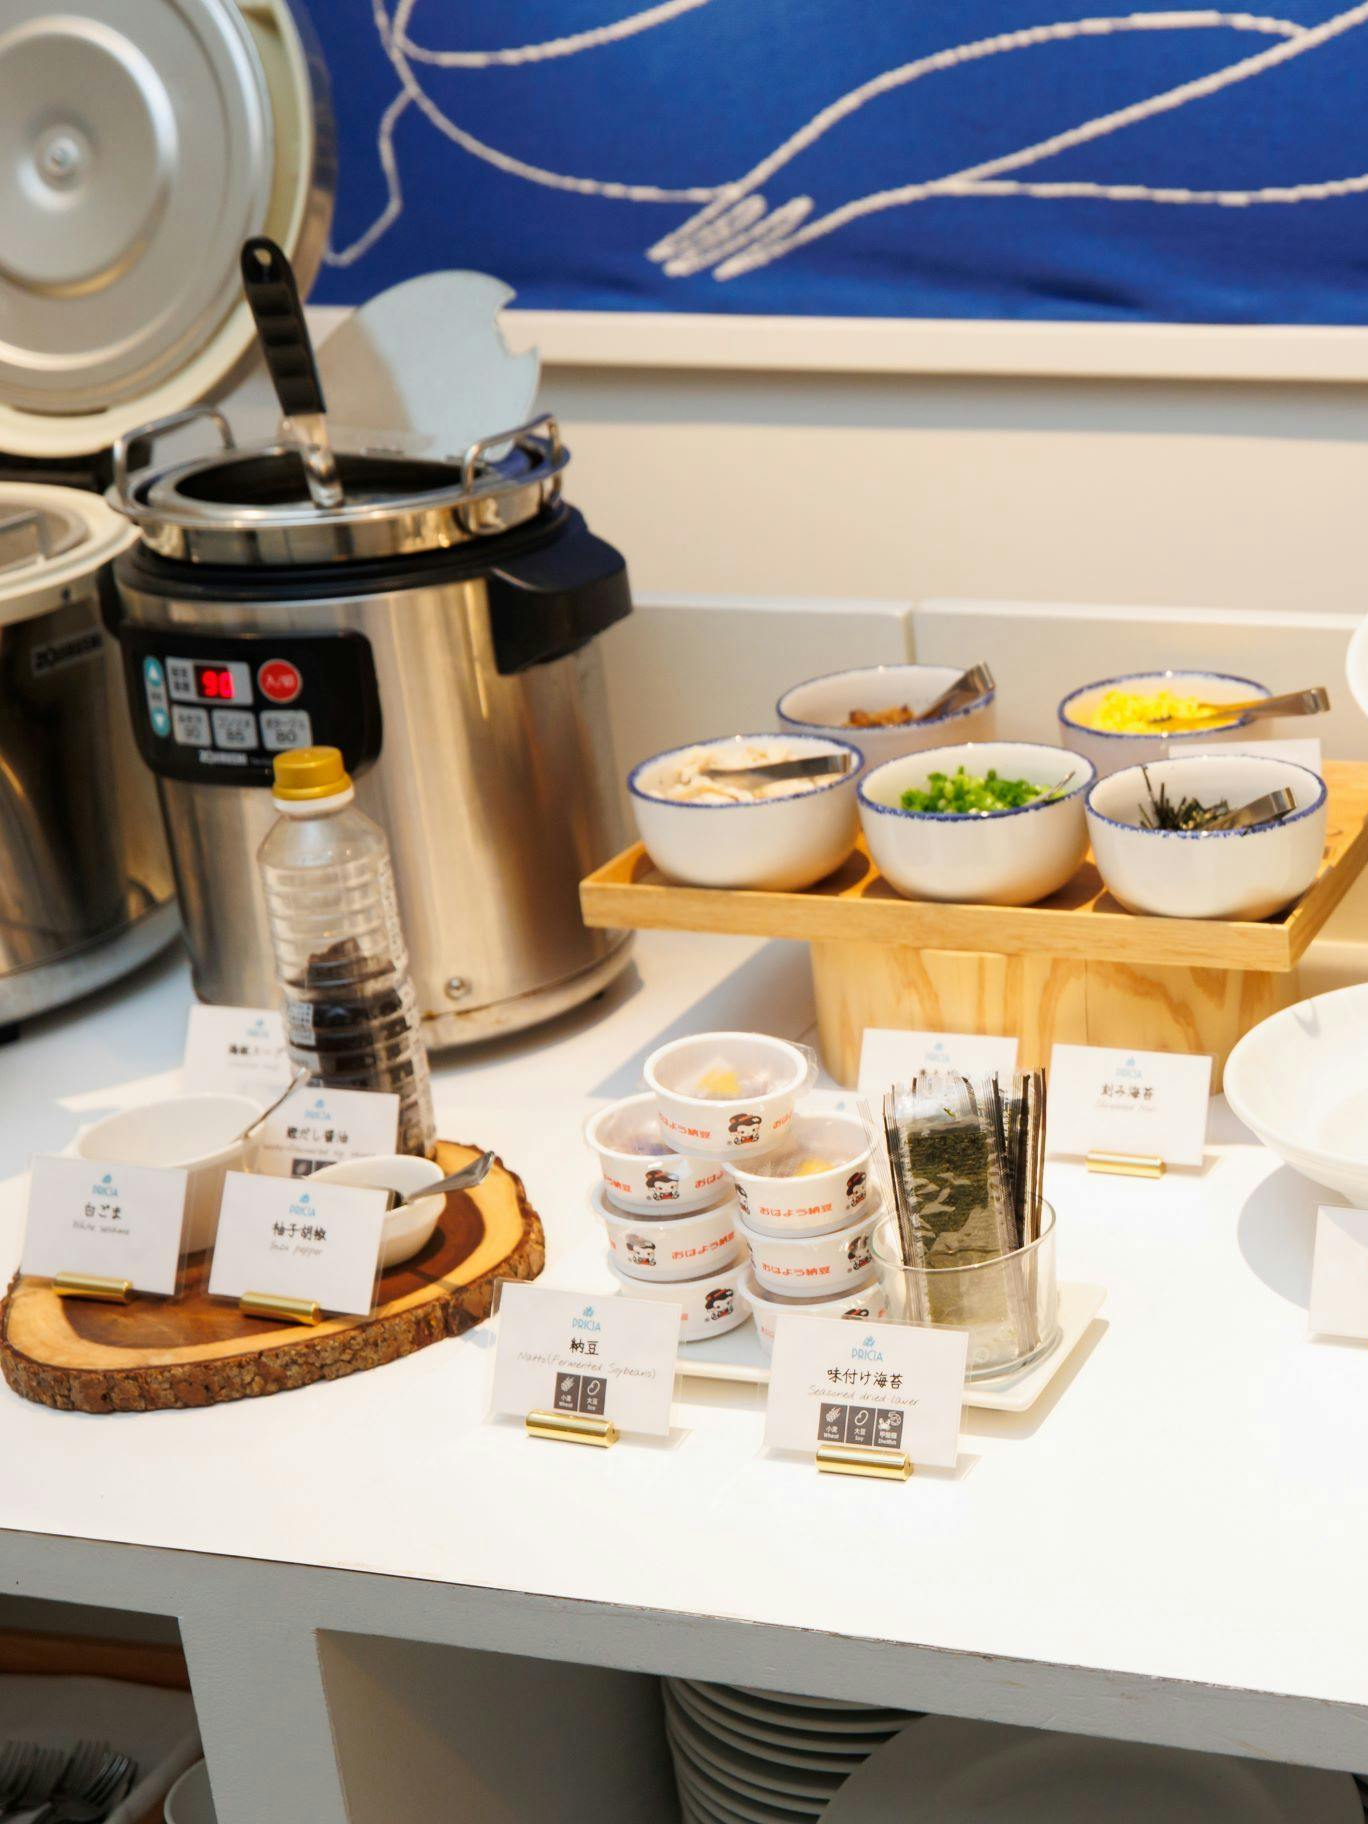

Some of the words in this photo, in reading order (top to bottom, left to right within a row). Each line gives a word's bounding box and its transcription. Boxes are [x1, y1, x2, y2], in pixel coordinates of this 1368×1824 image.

[201, 669, 235, 699] 90
[760, 1203, 833, 1217] おはよう納豆
[273, 1221, 327, 1241] 柚子胡椒
[672, 1231, 735, 1261] おはよう納豆
[762, 1263, 831, 1277] おはよう納豆
[572, 1317, 602, 1333] PRICIA
[569, 1336, 600, 1356] 納豆
[851, 1348, 884, 1362] PRICIA
[827, 1367, 904, 1390] 味付け海苔
